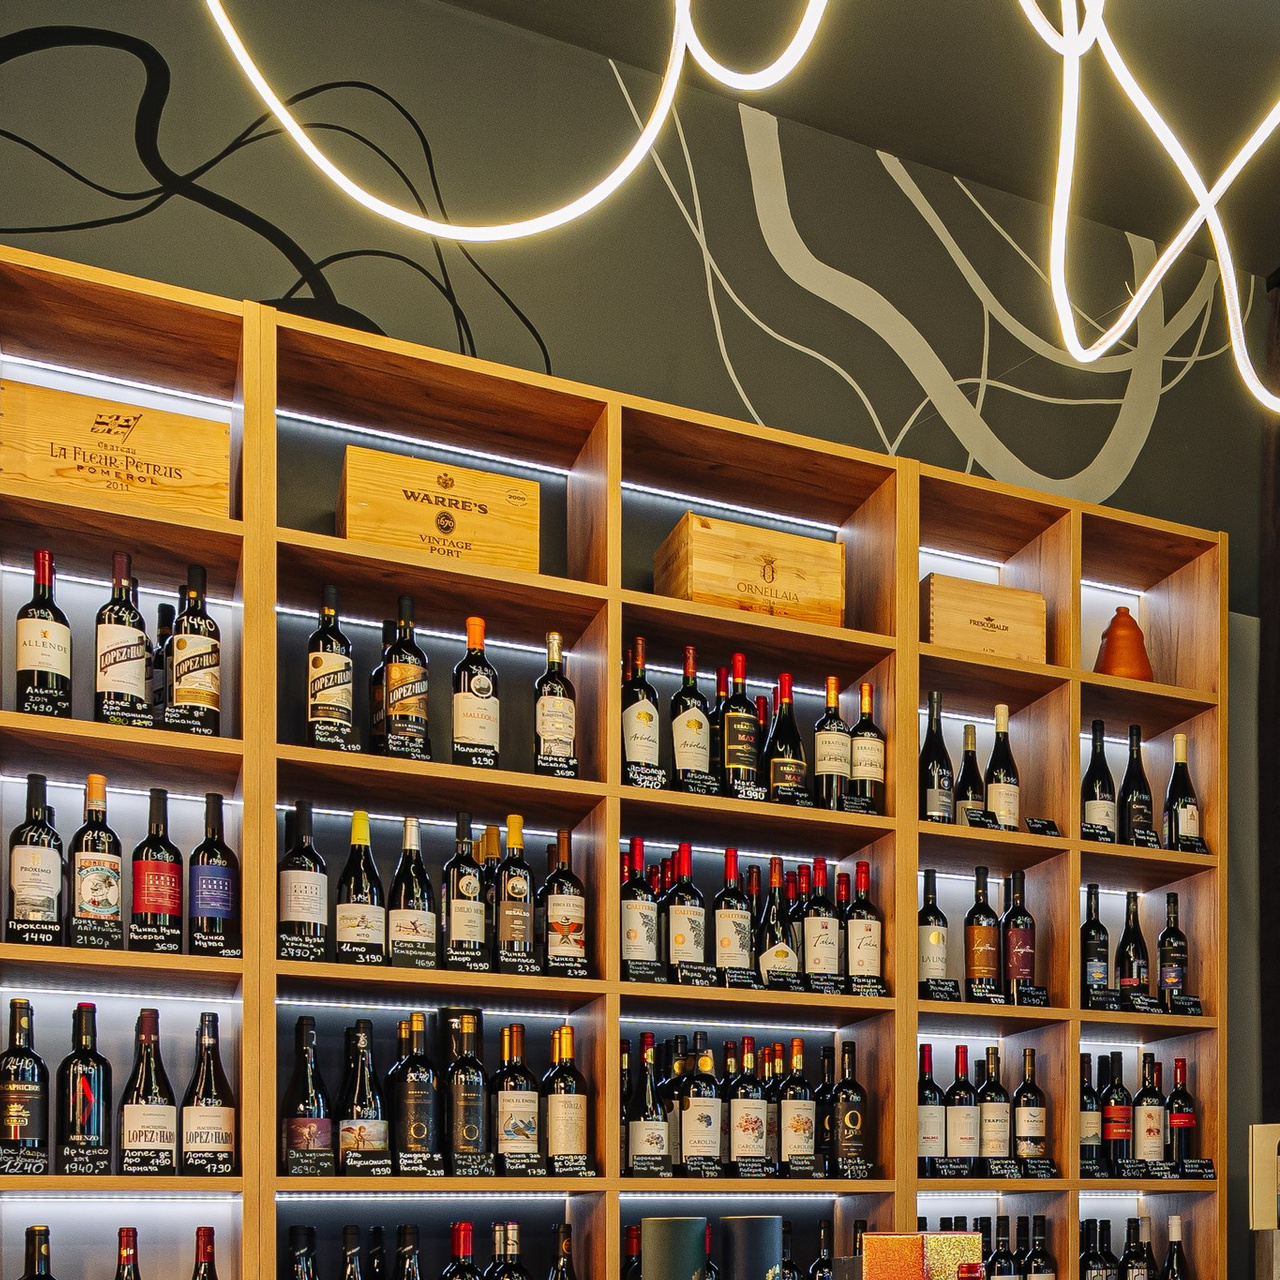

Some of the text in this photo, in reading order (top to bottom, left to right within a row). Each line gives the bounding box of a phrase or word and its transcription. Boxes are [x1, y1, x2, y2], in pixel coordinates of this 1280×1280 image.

[50, 442, 67, 460] LA
[77, 464, 158, 486] POMEROL
[106, 480, 130, 492] 2011
[402, 489, 488, 514] WARRE'S
[419, 534, 472, 551] VINTAGE
[430, 546, 462, 558] PORT
[736, 581, 800, 603] ORNELLAIA
[969, 619, 1009, 632] FRESCOBALDI
[21, 640, 68, 654] ALLENDE
[100, 650, 127, 667] LOPEZ
[176, 658, 200, 677] LOPEZ
[310, 677, 334, 694] LOPEZ
[389, 687, 412, 703] LOPEZ
[22, 933, 53, 942] 1440
[128, 1129, 155, 1143] LOPEZ
[186, 1131, 209, 1144] LOPEZ
